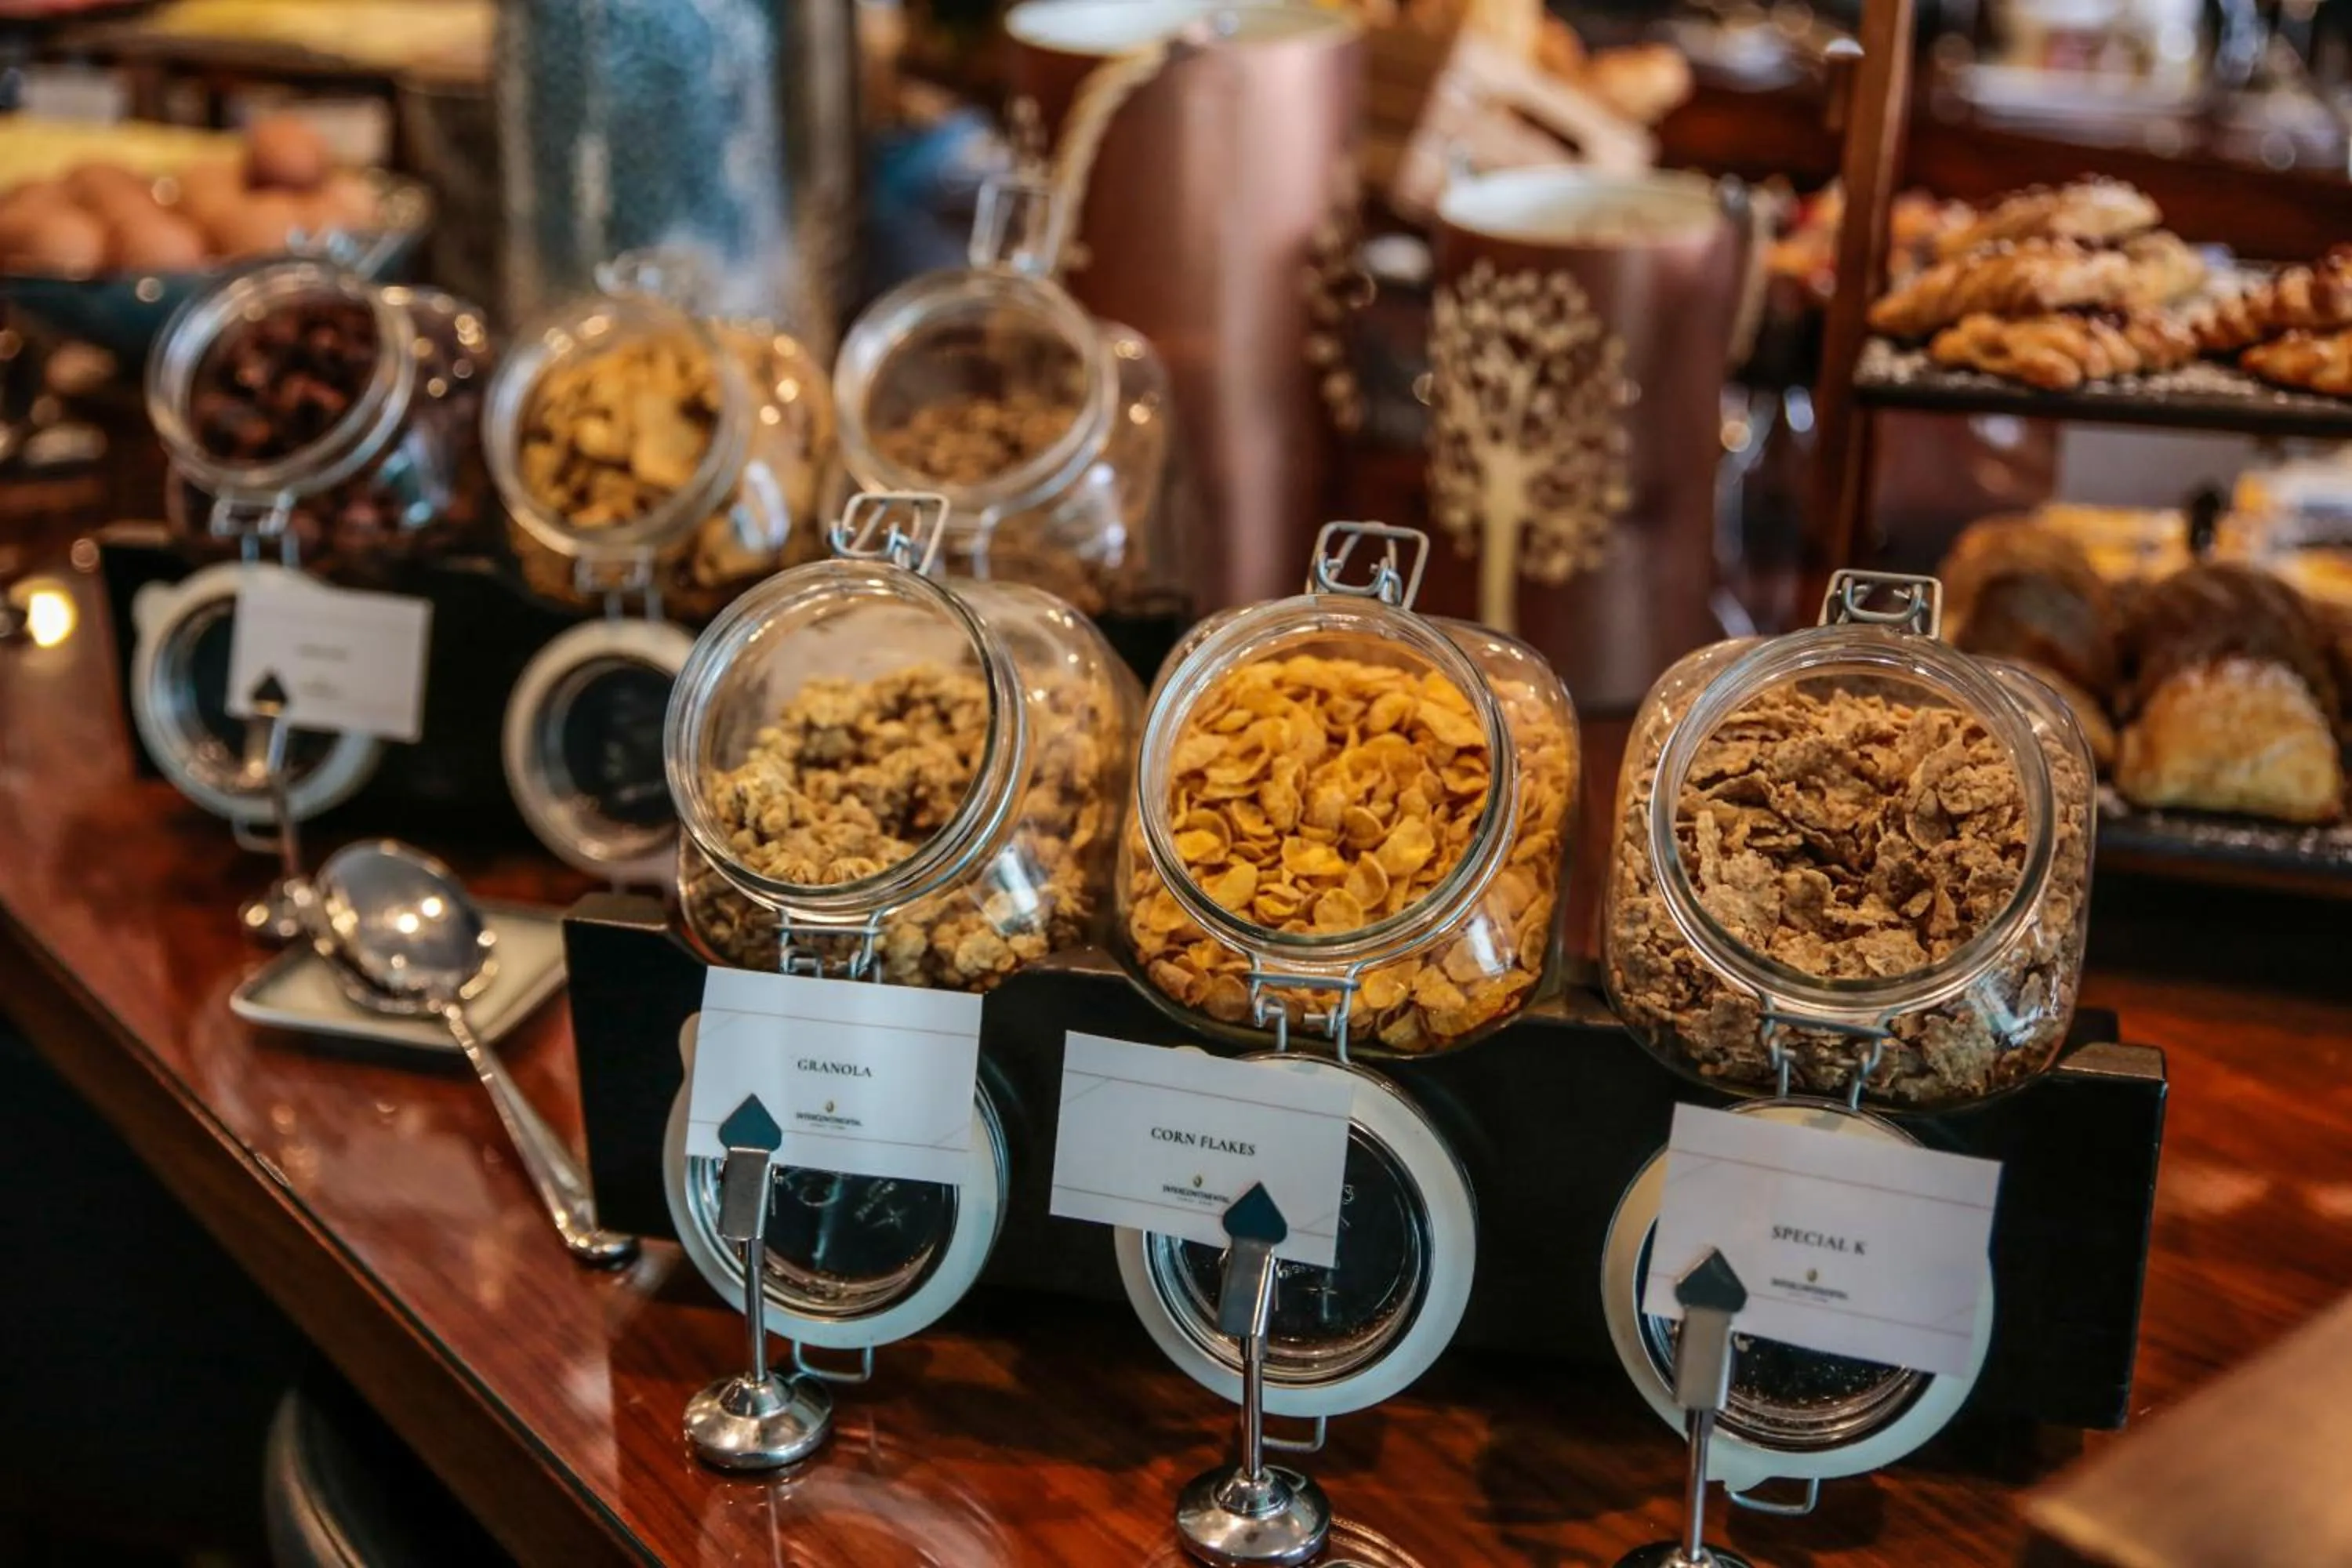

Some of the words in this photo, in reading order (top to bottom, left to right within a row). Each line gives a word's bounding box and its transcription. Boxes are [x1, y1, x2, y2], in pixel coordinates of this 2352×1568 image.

[797, 1058, 872, 1078] GRANOLA
[1150, 1127, 1196, 1145] CORN
[1200, 1134, 1256, 1156] FLAKES
[1771, 1224, 1849, 1252] SPECIAL
[1853, 1240, 1867, 1256] K
